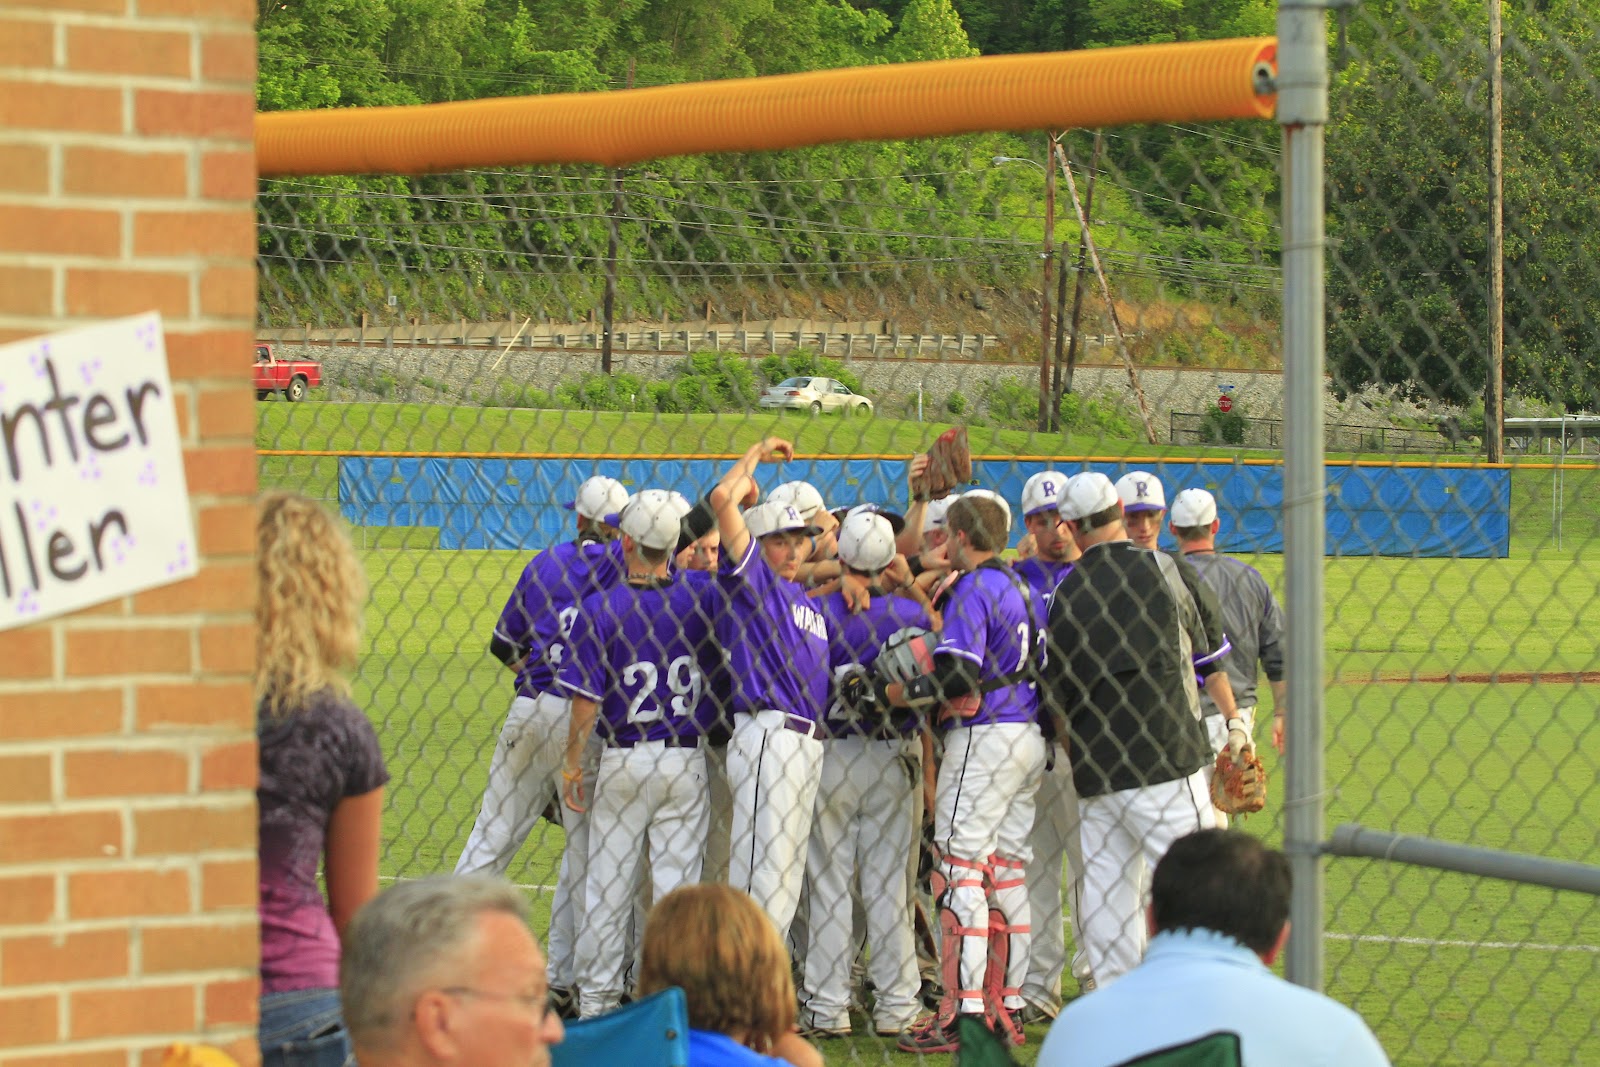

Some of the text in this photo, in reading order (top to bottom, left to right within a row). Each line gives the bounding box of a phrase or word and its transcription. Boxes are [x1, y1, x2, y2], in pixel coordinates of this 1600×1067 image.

[1218, 400, 1232, 408] STOP
[1, 357, 160, 482] nter
[1042, 480, 1056, 497] R
[1136, 481, 1149, 497] R
[623, 655, 701, 724] 29
